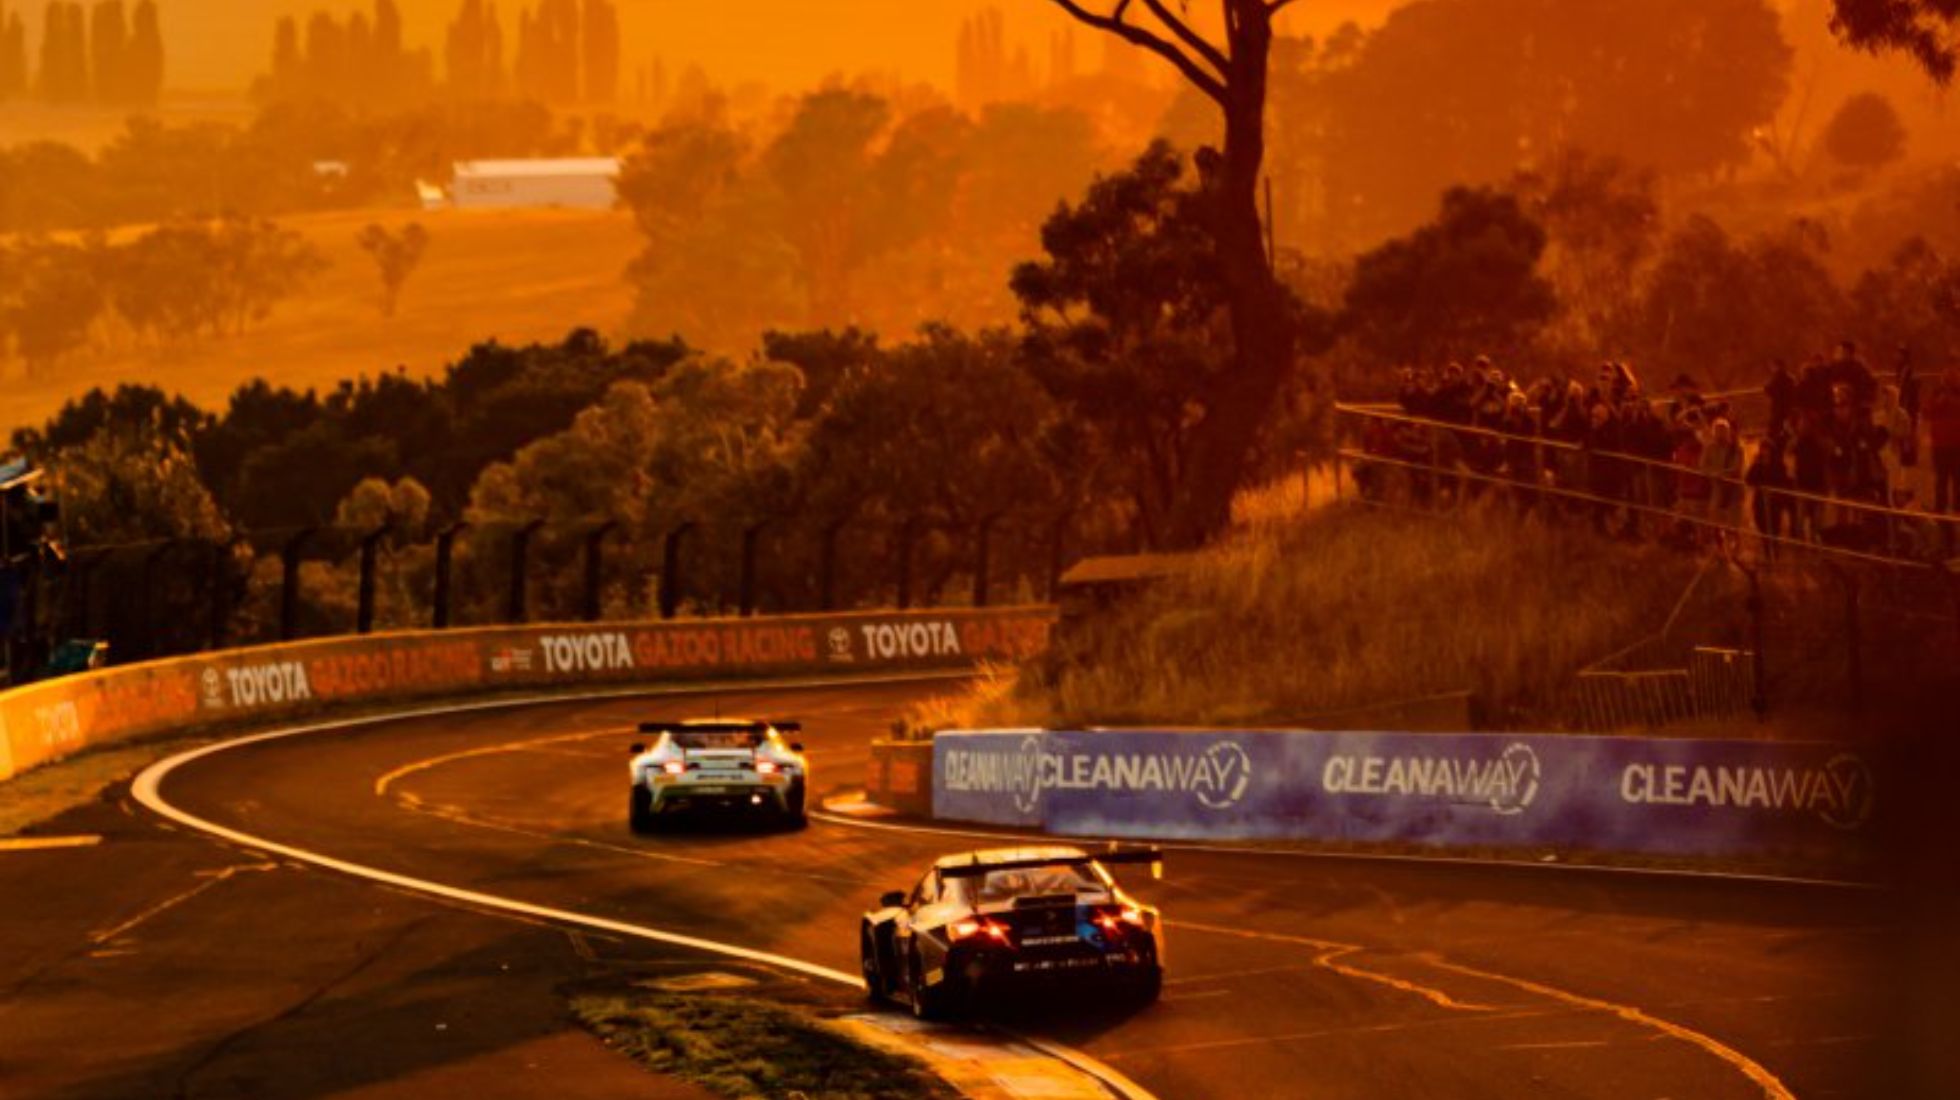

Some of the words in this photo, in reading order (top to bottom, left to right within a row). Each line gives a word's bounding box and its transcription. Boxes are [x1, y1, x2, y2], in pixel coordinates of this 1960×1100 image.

[540, 633, 633, 671] TOYOTA
[635, 629, 720, 667] GAZOO
[722, 626, 817, 663] RACING
[862, 622, 960, 658] TOYOTA
[227, 662, 310, 706] TOYOTA
[945, 749, 1036, 792] CLEANAWAY
[1041, 754, 1236, 790] CLEANAWAY
[1322, 755, 1528, 796] CLEANAWAY
[1620, 763, 1858, 809] CLEANAWAY
